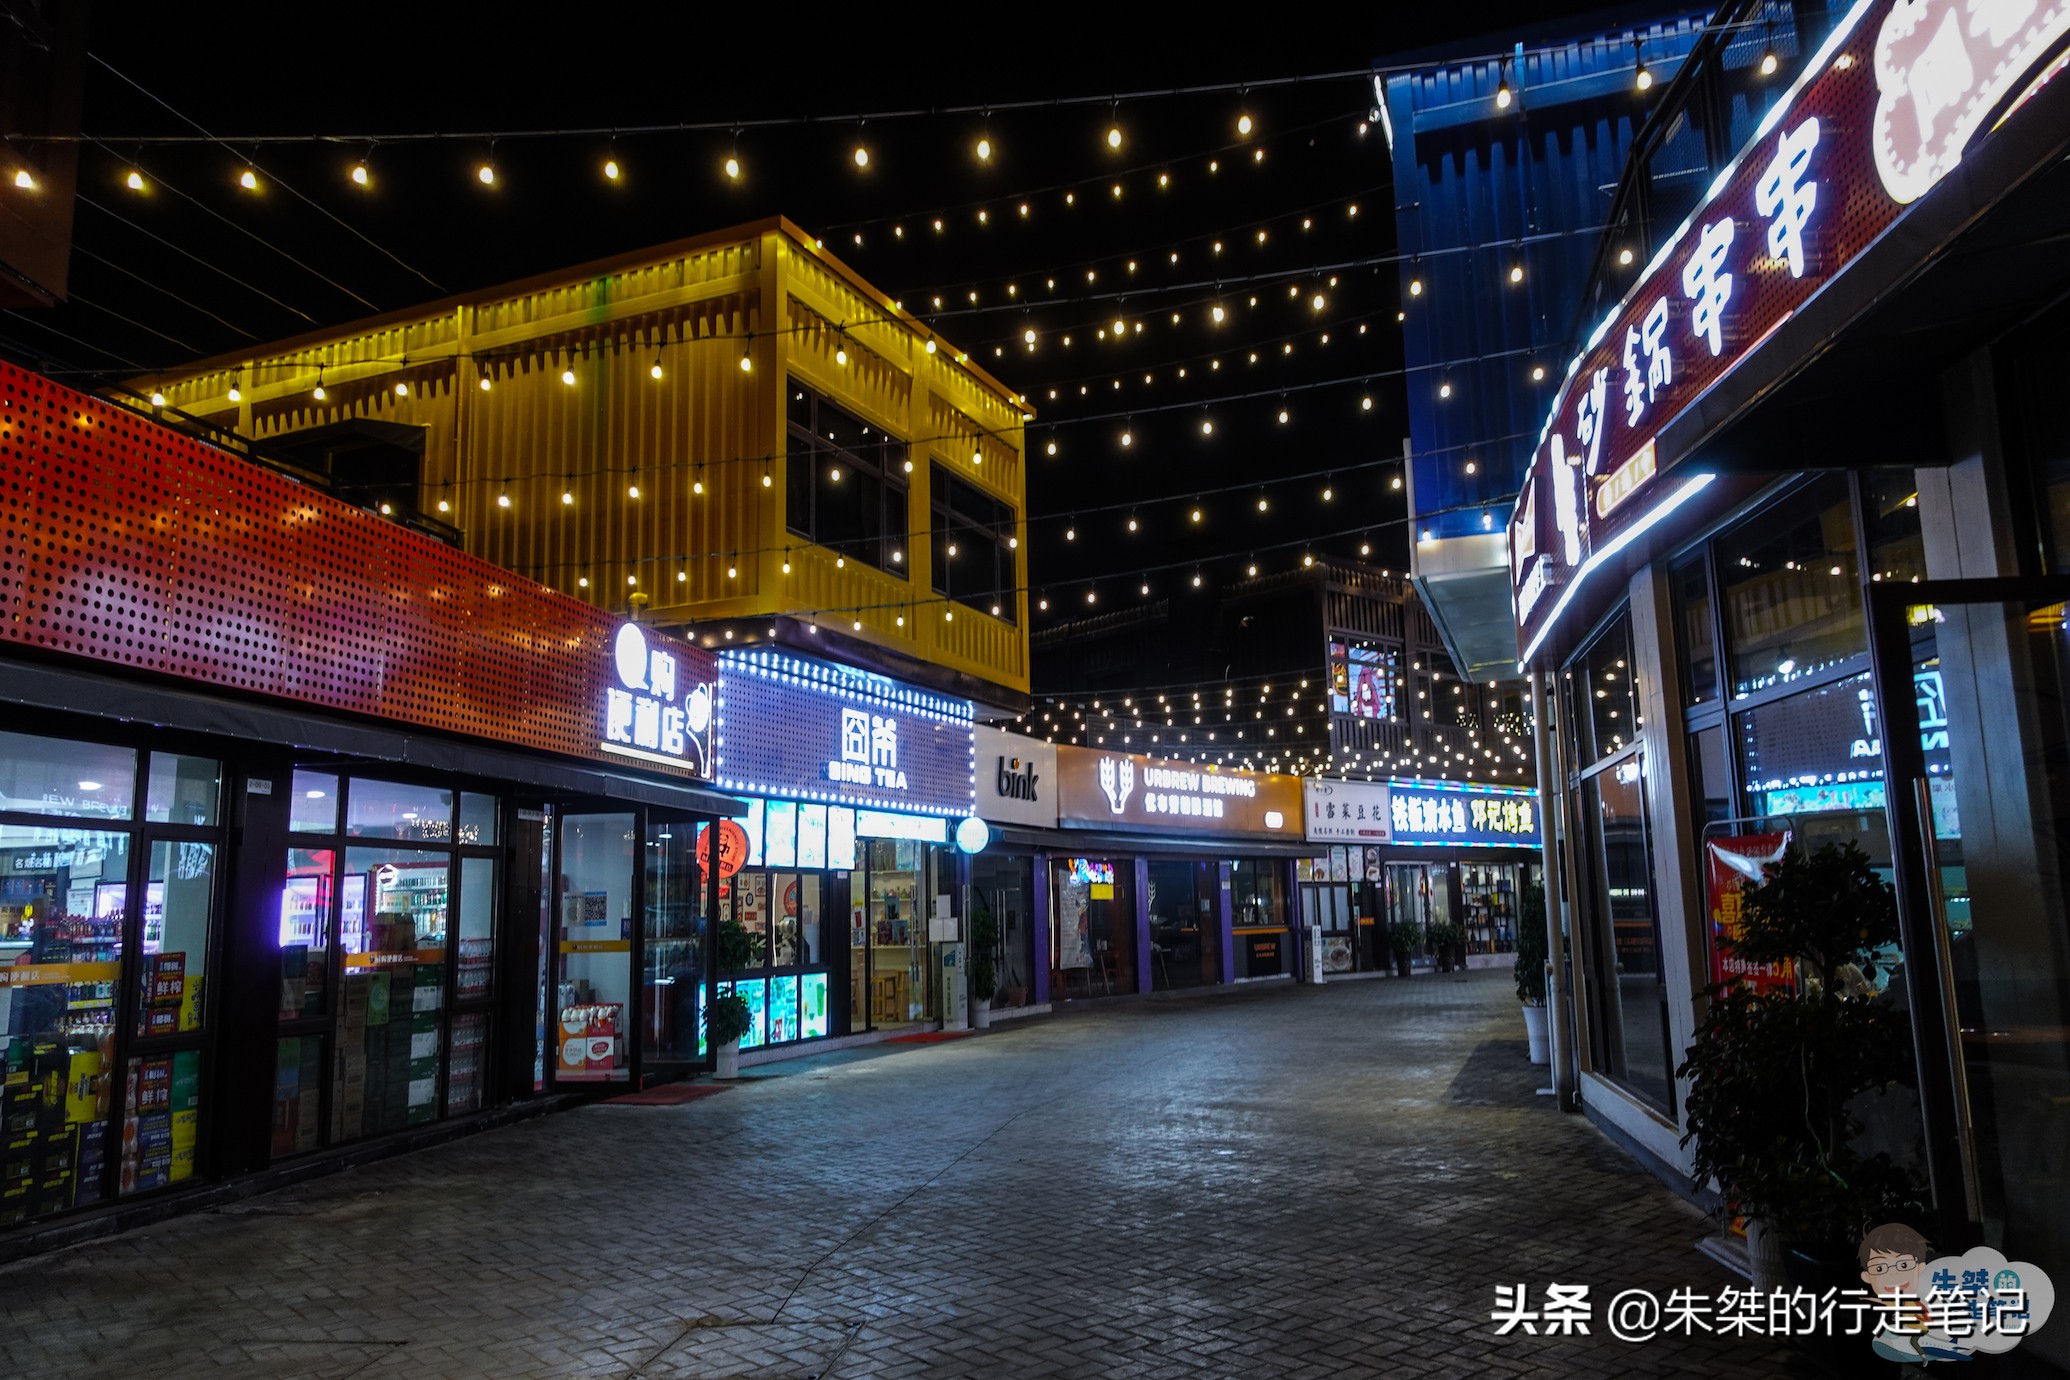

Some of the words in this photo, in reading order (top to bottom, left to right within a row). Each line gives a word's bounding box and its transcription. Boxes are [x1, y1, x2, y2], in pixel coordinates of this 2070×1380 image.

[606, 687, 685, 755] 便利店
[874, 767, 908, 790] TEA
[997, 756, 1039, 803] bink
[1143, 767, 1200, 792] URBREW
[1201, 774, 1256, 798] BREWING
